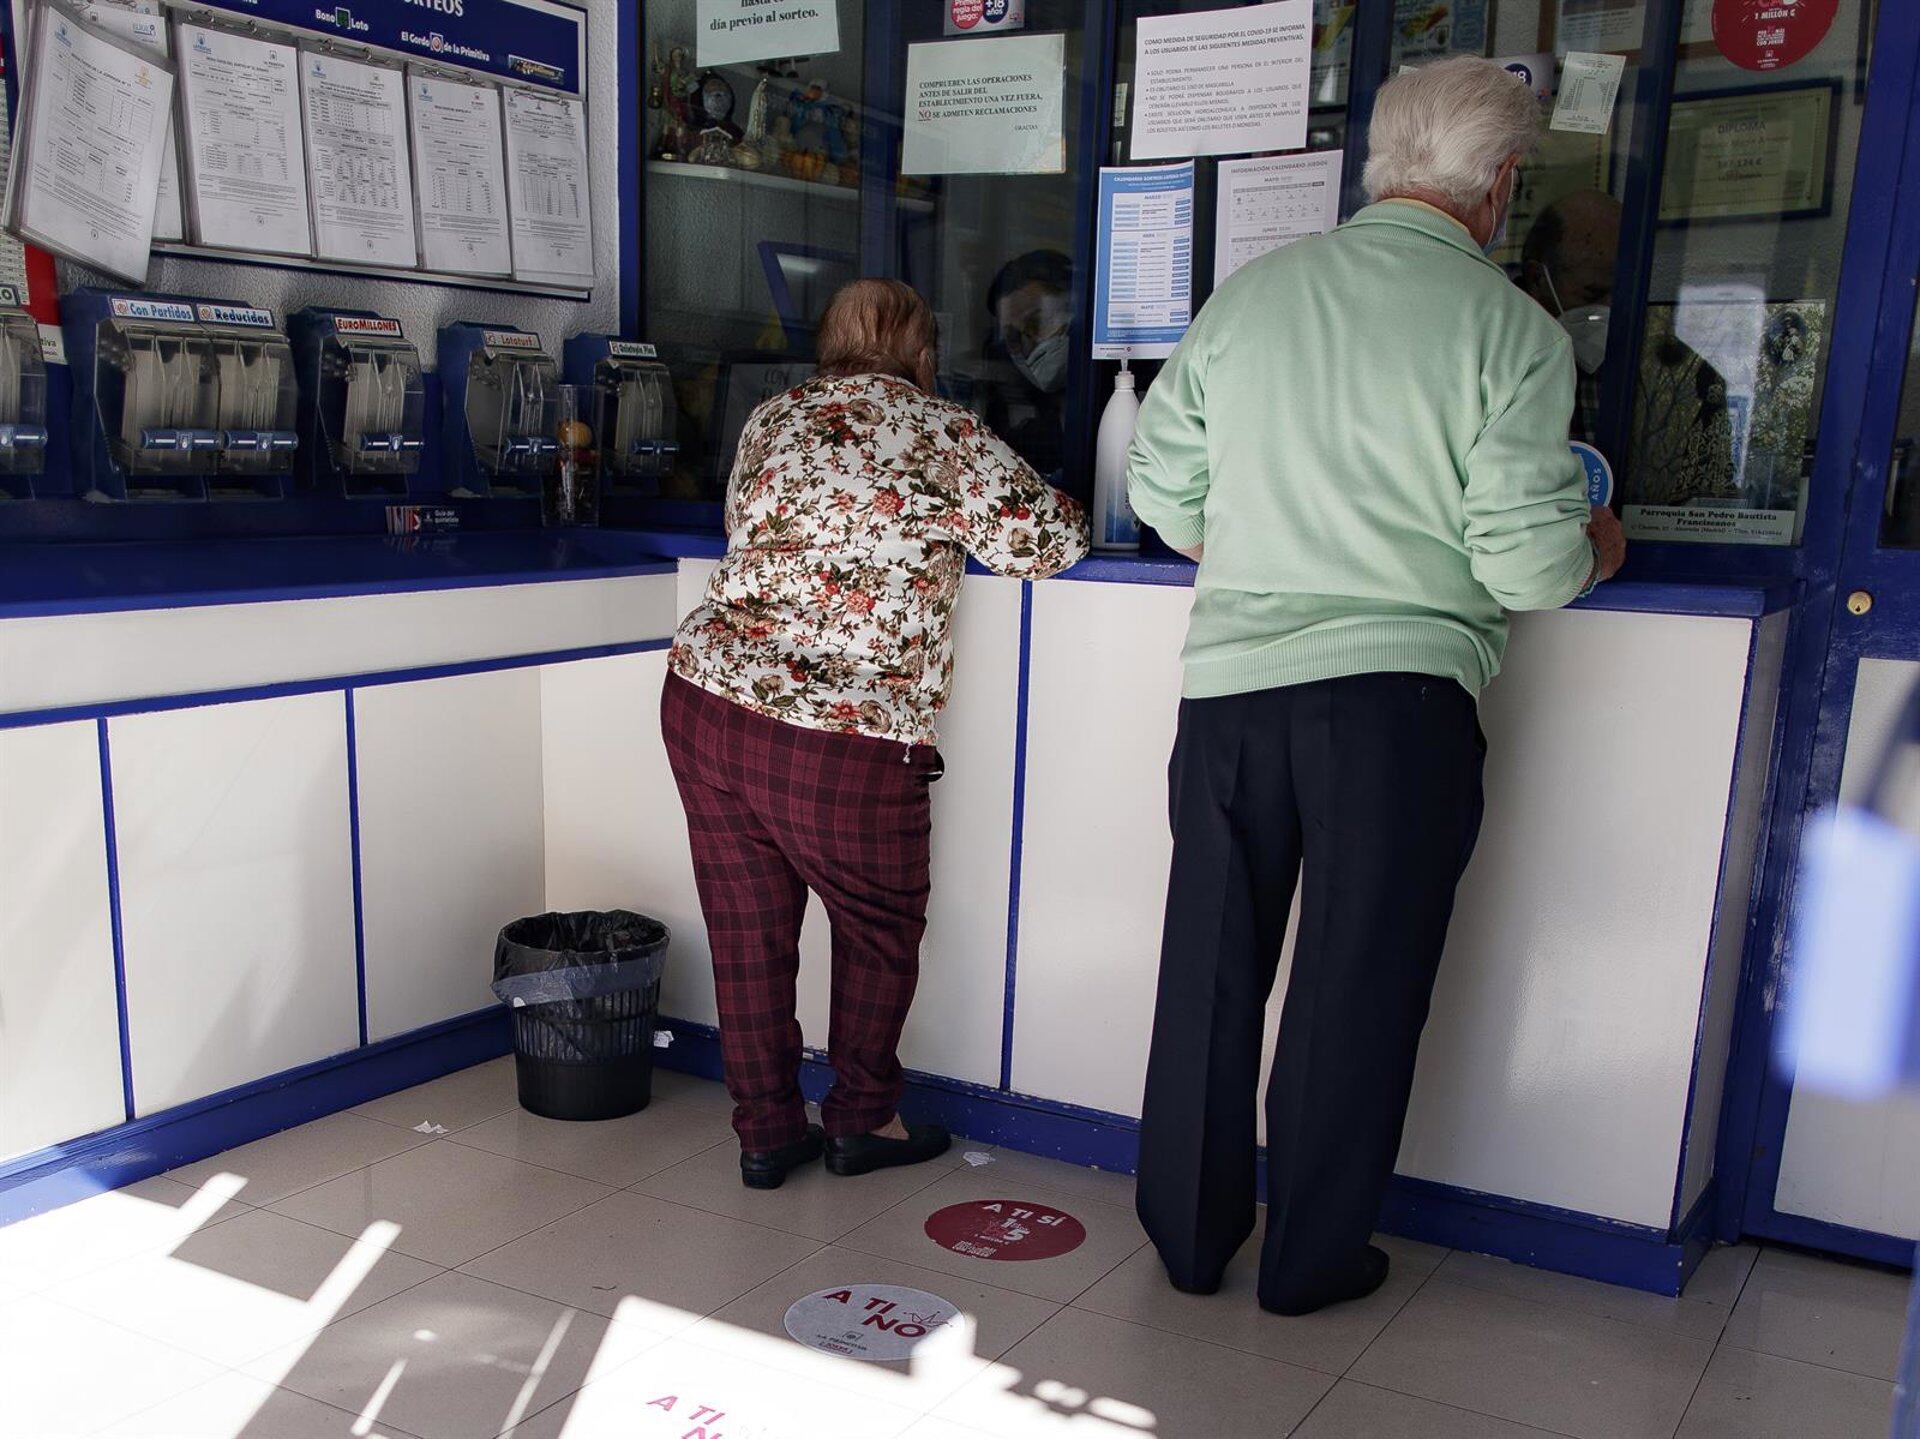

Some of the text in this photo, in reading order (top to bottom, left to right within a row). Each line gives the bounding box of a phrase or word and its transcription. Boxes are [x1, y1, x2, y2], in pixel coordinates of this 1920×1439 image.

[315, 9, 369, 31] Bono Loto
[710, 9, 819, 31] día previo al sorteo.
[1754, 12, 1759, 20] 1
[1761, 9, 1788, 19] MILLÓN
[1163, 36, 1186, 44] MEDIDA
[1195, 33, 1227, 42] SEGURIDAD
[1227, 31, 1239, 39] POR
[1246, 28, 1272, 37] COVID-19
[1279, 23, 1306, 32] INFORMA
[401, 31, 490, 62] El Gordo de la Primitiva
[1149, 47, 1160, 55] LOS
[1160, 45, 1189, 54] USUARIOS
[1208, 41, 1241, 50] SIGUIENTES
[1241, 38, 1267, 47] MEDIDAS
[919, 74, 1033, 89] COMPRUEBEN LAS OPERACIONES
[919, 87, 987, 99] ANTES DE SALIR DEL
[919, 96, 983, 108] ESTABLECIMIENTO
[984, 95, 999, 104] UNA
[1000, 94, 1015, 103] VEZ
[918, 105, 1038, 121] NO SE ADMITEN RECLAMACIONES
[1718, 121, 1767, 134] DIPLOMA
[130, 302, 192, 320] Con Partidos
[215, 311, 270, 325] Reducidas
[501, 334, 534, 346] Lototurf
[1640, 508, 1777, 521] Parroquia San Pedro Bautista
[1676, 518, 1736, 527] Franciscanos
[982, 1203, 1002, 1213] A
[1011, 1208, 1034, 1219] TI
[822, 1289, 898, 1315] A TI
[861, 1313, 927, 1338] NO
[646, 1395, 726, 1426] A TI
